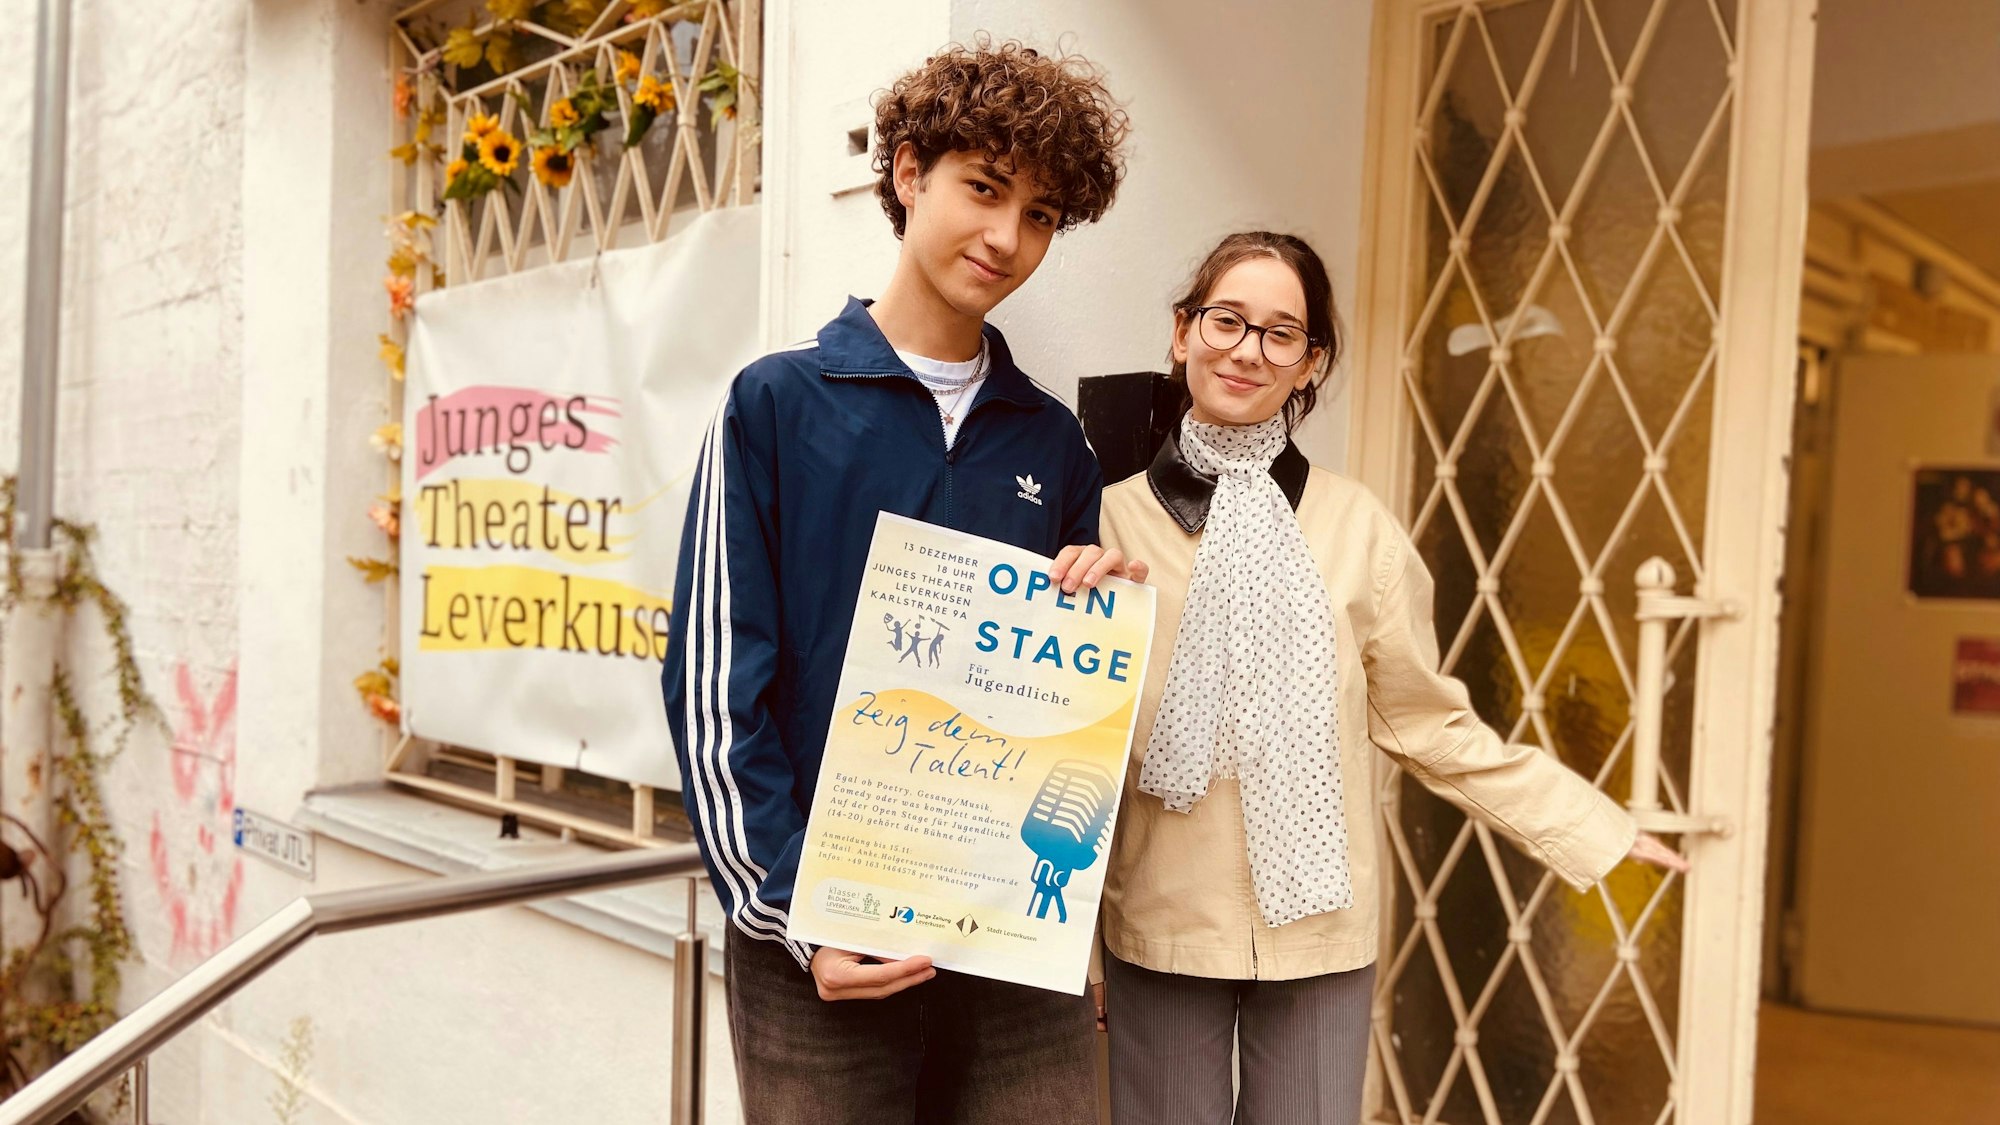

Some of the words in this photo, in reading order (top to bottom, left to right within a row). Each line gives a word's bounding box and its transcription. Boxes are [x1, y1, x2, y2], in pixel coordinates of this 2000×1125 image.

[422, 394, 588, 474] Junges
[1017, 491, 1042, 505] adidas
[421, 478, 622, 553] Theater
[904, 542, 914, 552] 13
[919, 546, 978, 567] DEZEMBER
[872, 563, 916, 580] JUNGES
[922, 574, 973, 594] THEATER
[937, 564, 948, 574] 18
[953, 568, 976, 580] UHR
[870, 590, 948, 615] KARLSTRAßE
[953, 609, 967, 620] 9A
[895, 582, 971, 607] LEVERKUSEN
[988, 563, 1116, 620] OPEN
[419, 573, 672, 666] Leverkuse
[975, 620, 1132, 683] STAGE
[969, 663, 990, 676] Für
[965, 673, 1070, 706] Jugendliche
[852, 691, 908, 755] Zeig
[928, 712, 1006, 747] dein
[910, 742, 1028, 782] Talent!
[836, 772, 858, 784] Egal
[861, 778, 873, 787] ob
[833, 784, 872, 800] Comedy
[875, 794, 898, 804] oder
[902, 800, 920, 809] was
[924, 803, 968, 819] komplett
[827, 808, 863, 823] (14-20)
[867, 818, 900, 830] gehört
[904, 824, 919, 833] die
[923, 827, 954, 841] Bühne
[957, 835, 977, 845] dir!
[830, 797, 849, 808] Auf
[851, 801, 868, 810] der
[872, 805, 897, 816] Open
[901, 810, 929, 823] Stage
[931, 817, 948, 827] für
[952, 821, 1011, 840] Jugendliche
[822, 831, 871, 847] Anmeldung
[874, 841, 887, 849] bis
[847, 857, 862, 866] +49
[865, 860, 880, 869] 163
[882, 864, 917, 876] 1464578
[919, 872, 933, 880] per
[937, 874, 979, 890] Whatsapp
[826, 901, 860, 912] LEVERKUSEN
[916, 912, 932, 920] Junge
[915, 919, 946, 929] Leverkusen
[986, 926, 1002, 935] Stadt
[1003, 930, 1038, 942] Leverkusen
